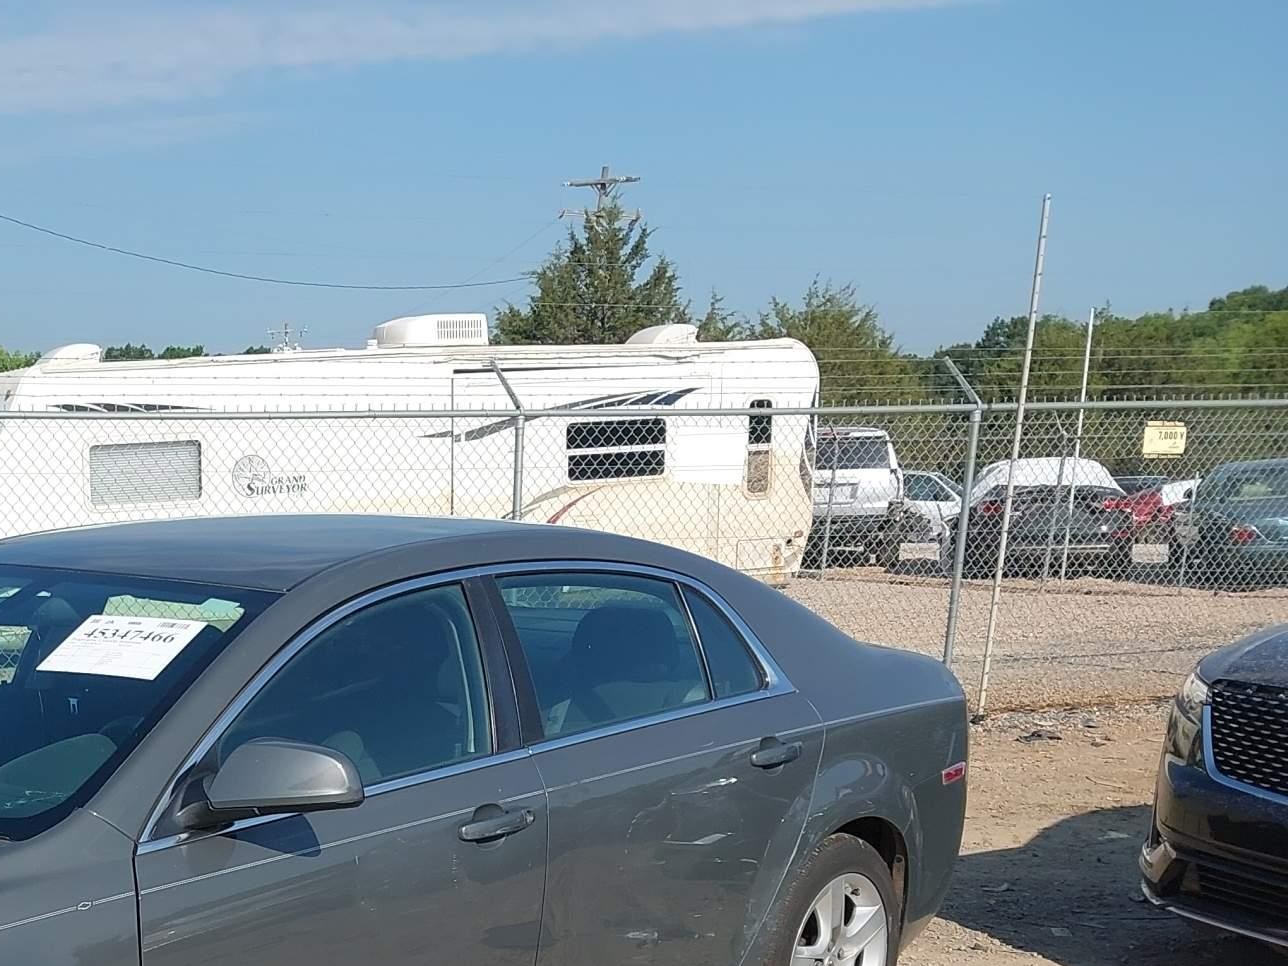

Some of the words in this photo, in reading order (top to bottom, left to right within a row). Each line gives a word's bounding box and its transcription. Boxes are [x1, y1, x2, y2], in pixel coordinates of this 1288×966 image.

[1158, 431, 1178, 440] 7,000
[271, 475, 305, 485] GRAND
[246, 482, 308, 497] SURVEYOR
[83, 628, 180, 644] 45347466
